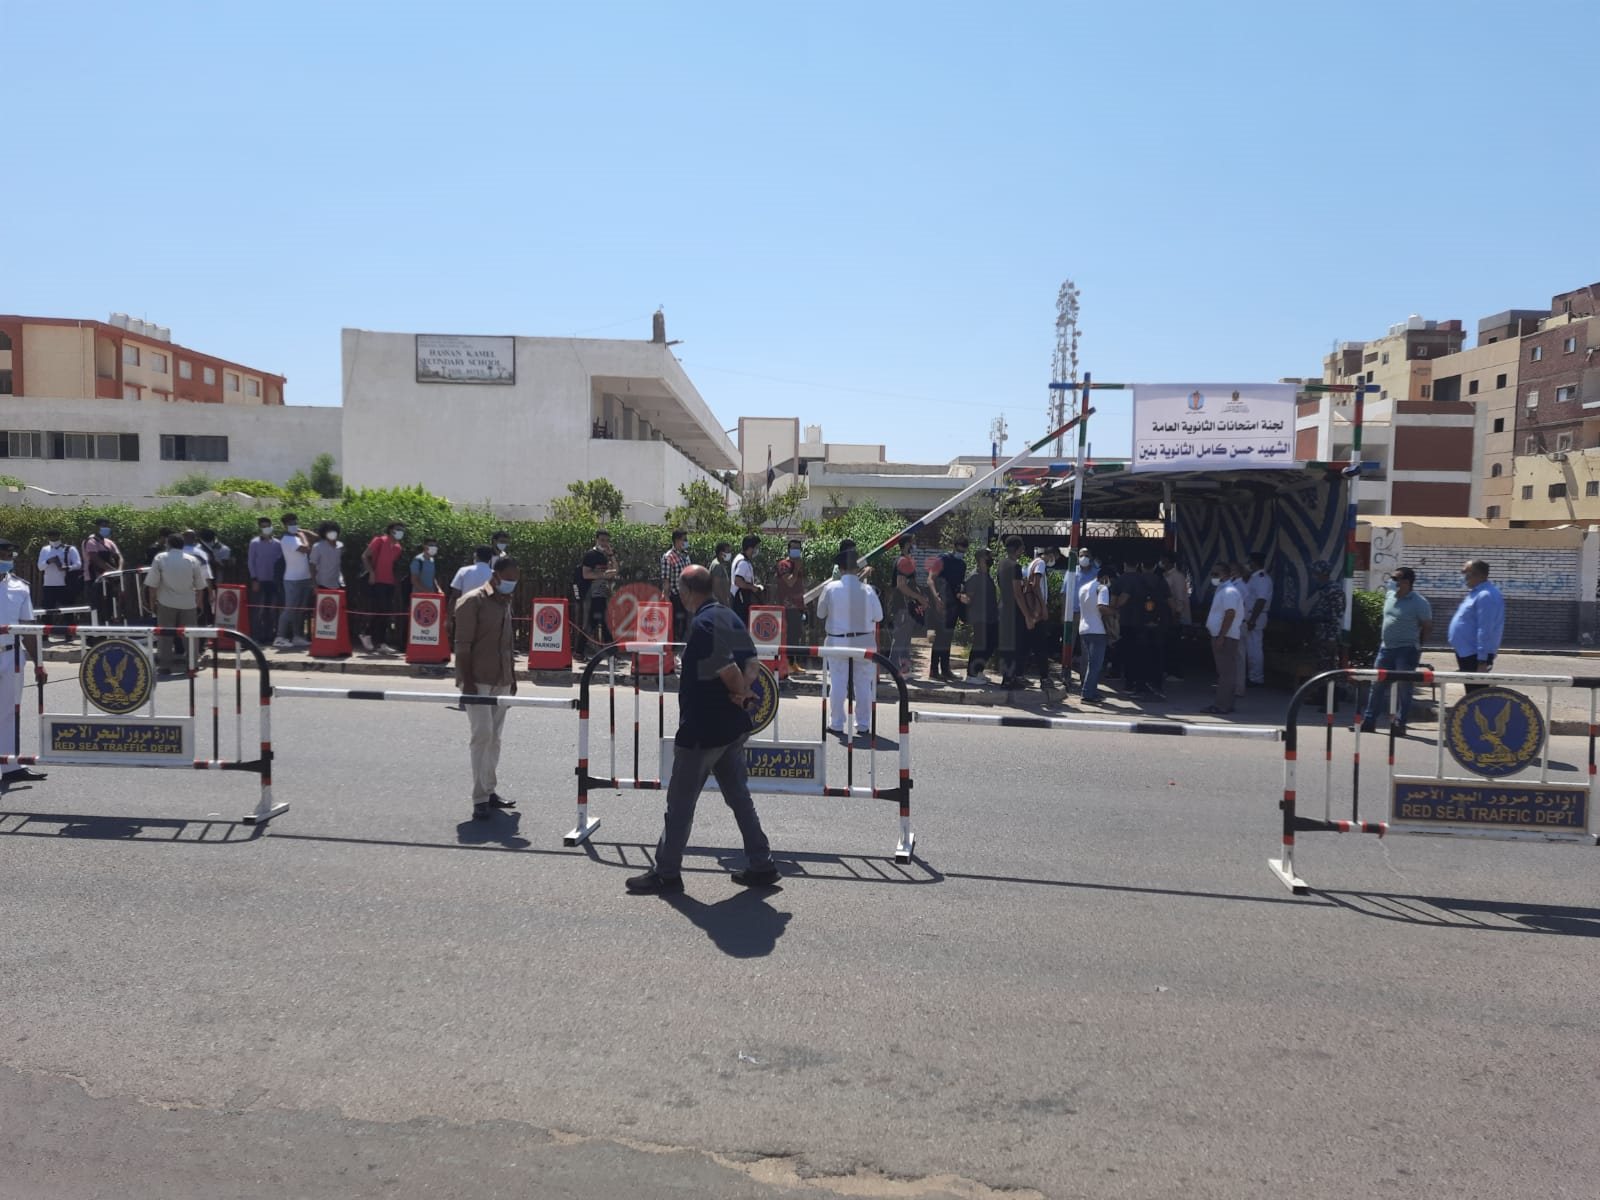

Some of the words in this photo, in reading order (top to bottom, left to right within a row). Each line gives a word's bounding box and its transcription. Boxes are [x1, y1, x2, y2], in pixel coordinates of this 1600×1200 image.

[466, 349, 496, 358] KAMEL
[1152, 421, 1180, 432] العامة
[1181, 419, 1215, 435] الثانوية
[1217, 419, 1259, 431] امتحانات
[1261, 419, 1284, 433] لجنة
[1139, 444, 1158, 460] بنين
[1160, 441, 1194, 460] الثانوية
[1197, 443, 1227, 459] كامل
[1230, 444, 1255, 459] حسن
[1258, 440, 1291, 458] الشهيد
[412, 634, 438, 642] PARKING
[95, 726, 125, 742] البحر
[128, 730, 151, 744] مرور
[55, 741, 76, 750] RED
[79, 742, 99, 751] SEA
[102, 742, 146, 752] TRAFFIC
[754, 753, 782, 768] مرور
[780, 768, 812, 778] DEPT.
[1487, 794, 1529, 806] مرور
[1402, 803, 1432, 818] RED
[1435, 805, 1466, 820] SEA
[1469, 807, 1531, 823] TRAFFIC
[1535, 809, 1577, 825] DEPT.
